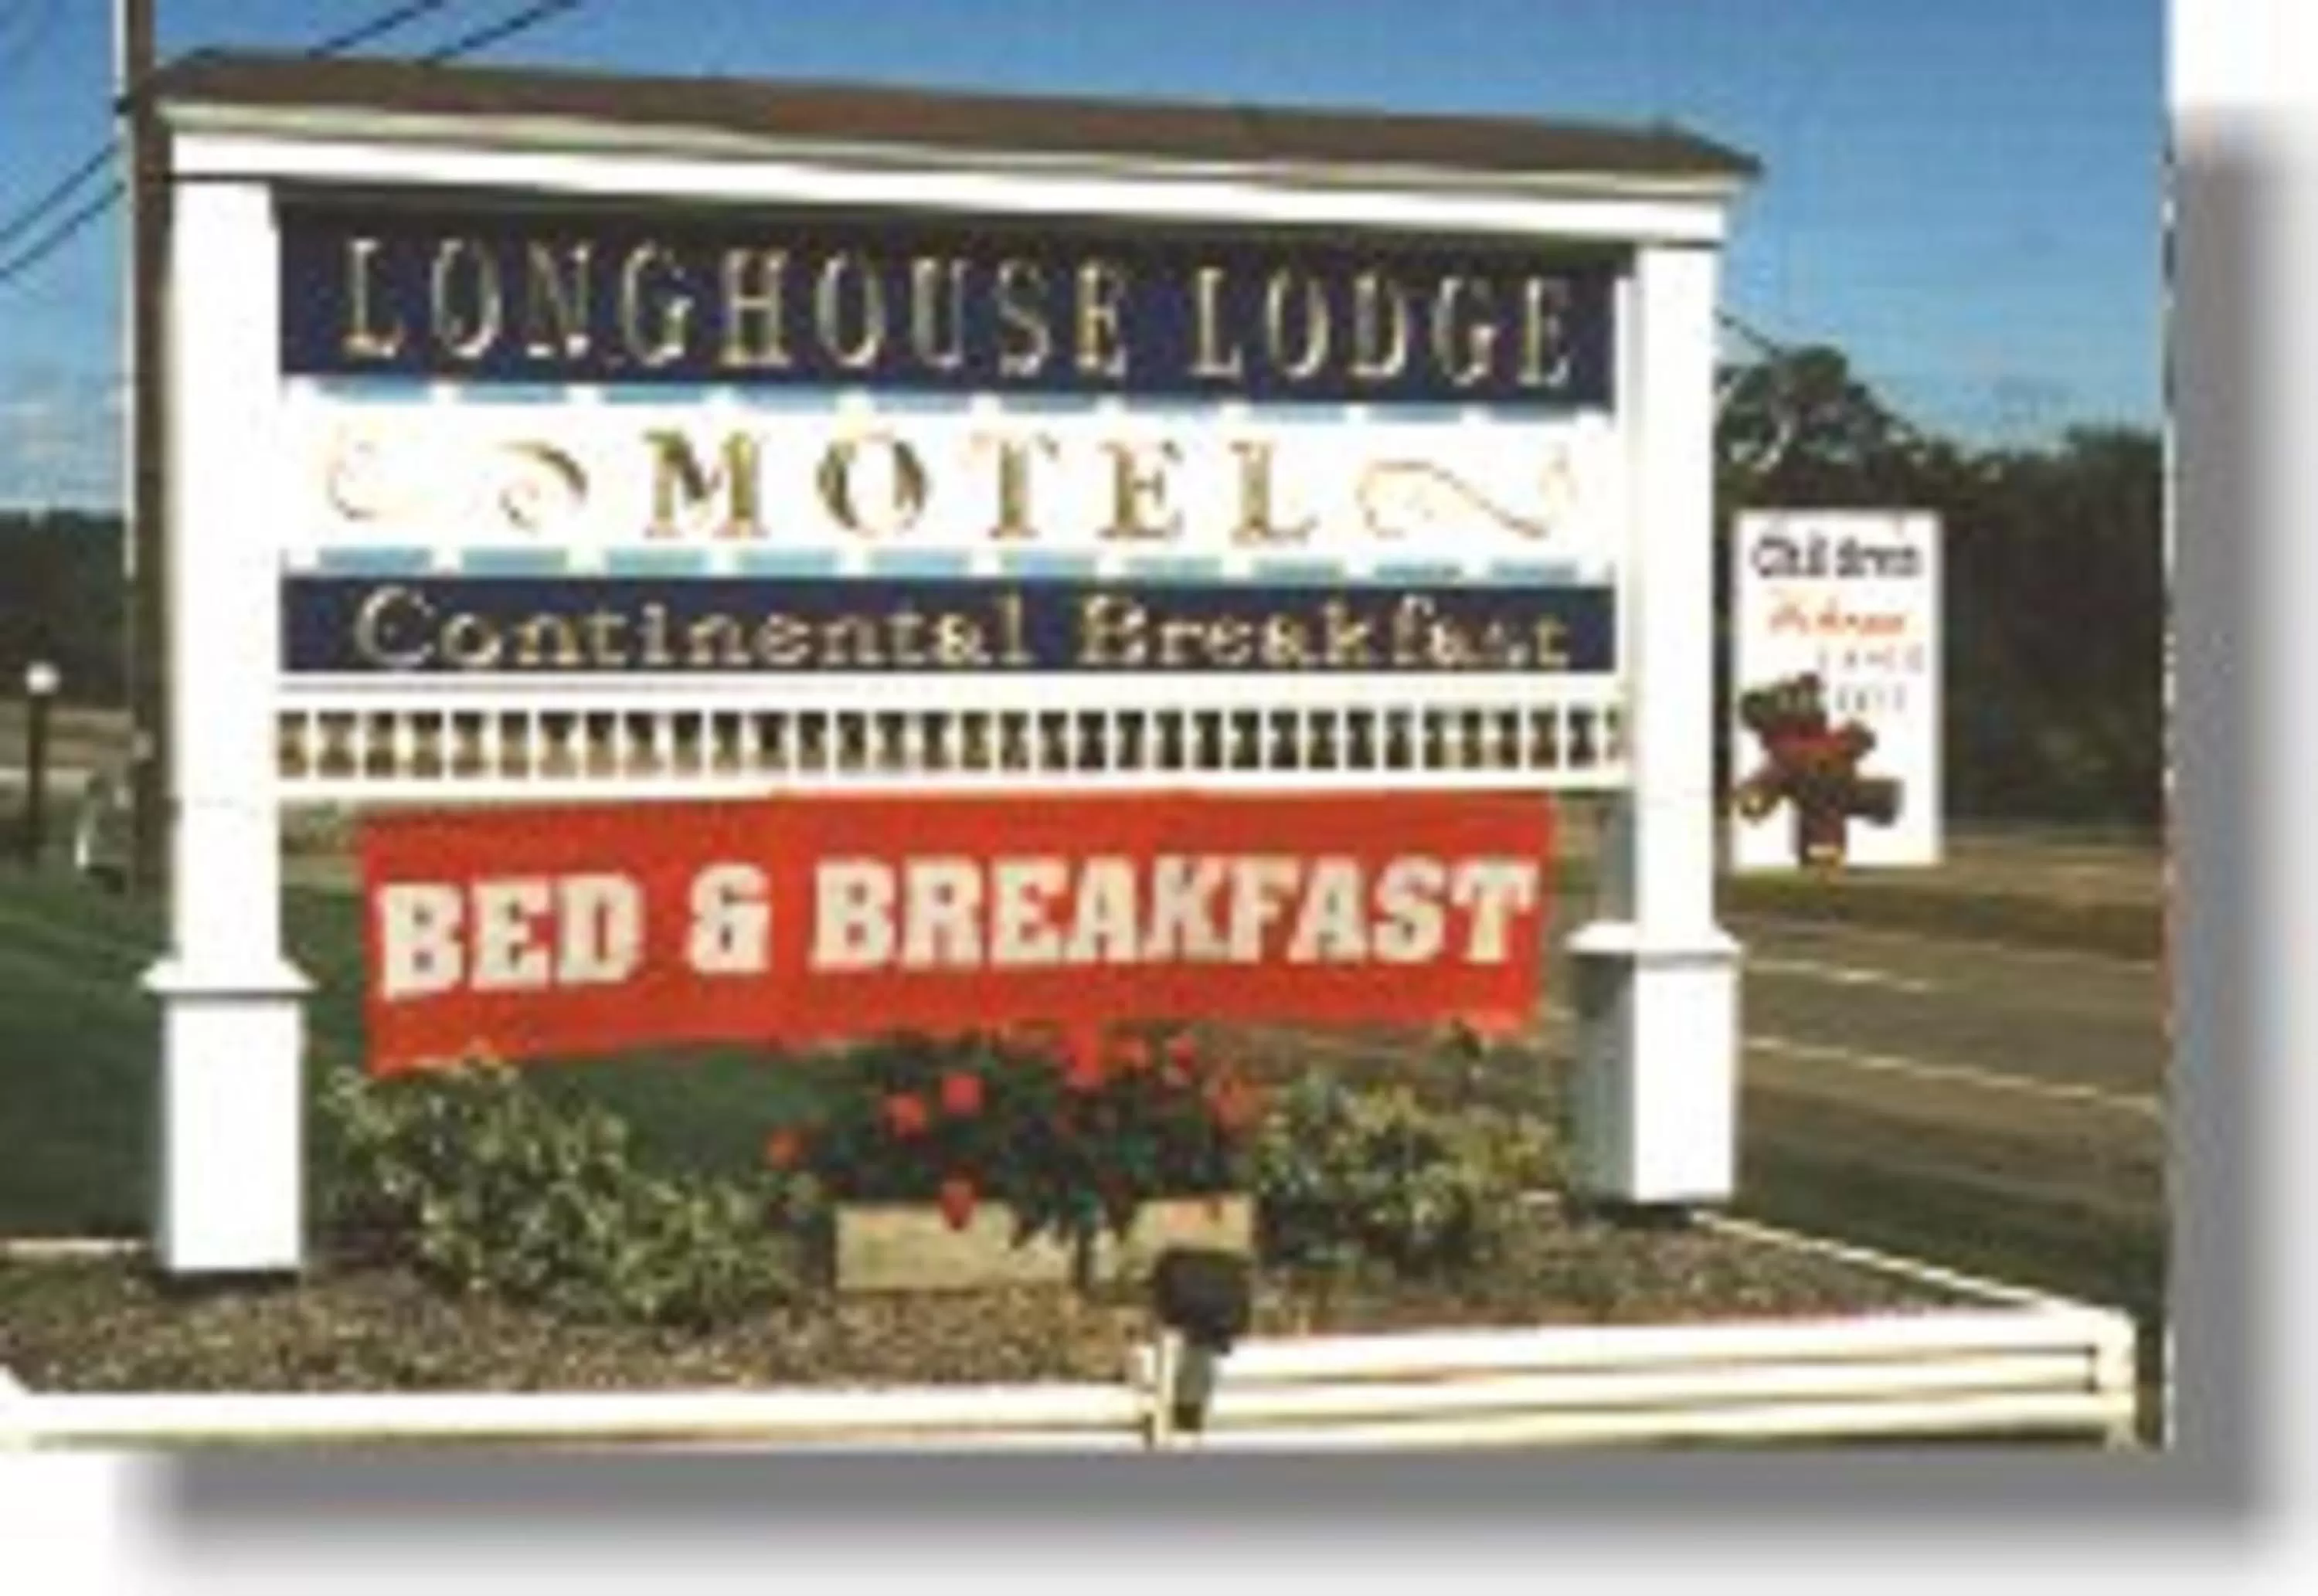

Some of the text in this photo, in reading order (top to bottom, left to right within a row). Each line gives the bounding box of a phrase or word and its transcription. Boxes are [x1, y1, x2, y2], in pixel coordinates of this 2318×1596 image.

[342, 237, 1572, 386] LONGHOUSE LODGE
[643, 427, 1317, 544] MOTEL
[354, 585, 1572, 669] Continental Breakfast
[376, 855, 1539, 999] BED & BREAKFAST
